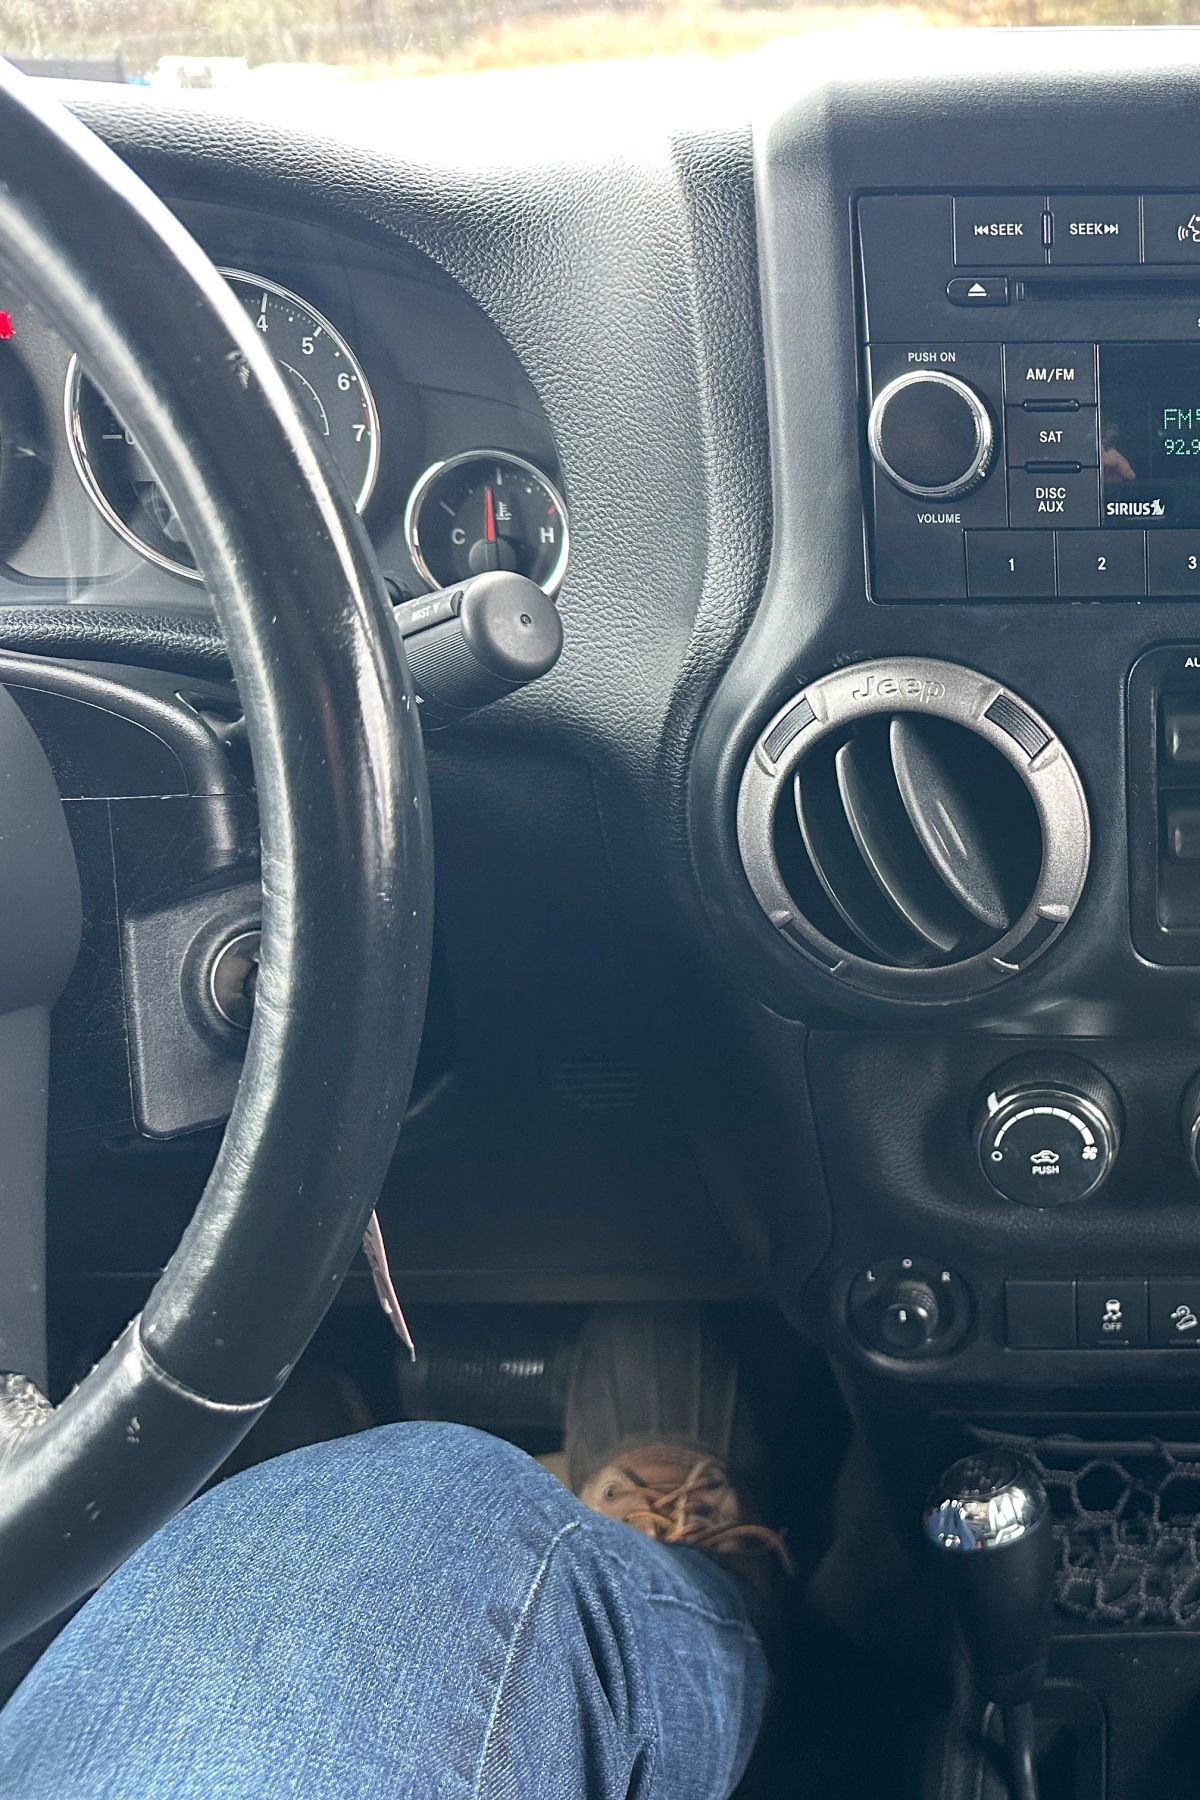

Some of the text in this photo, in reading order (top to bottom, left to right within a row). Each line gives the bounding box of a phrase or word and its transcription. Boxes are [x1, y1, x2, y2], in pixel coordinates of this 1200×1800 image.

[990, 223, 1024, 236] SEEK
[1069, 222, 1103, 236] SEEK
[256, 314, 269, 332] 4
[301, 336, 315, 355] 5
[907, 351, 956, 363] PUSH ON
[337, 372, 351, 391] 6
[1026, 367, 1075, 383] AM/FM
[1163, 408, 1192, 430] FM
[352, 424, 366, 442] 7
[1039, 430, 1064, 443] SAT
[1164, 438, 1200, 456] 92.9
[1035, 487, 1067, 499] DISC
[1037, 500, 1065, 513] AUX
[1106, 502, 1151, 516] SIRIUS
[916, 513, 961, 524] VOLUME
[452, 528, 466, 545] C
[540, 527, 555, 544] H
[1008, 558, 1015, 572] 1
[1097, 556, 1107, 571] 2
[1188, 555, 1198, 570] 3
[411, 605, 432, 622] MIST
[851, 674, 947, 704] Jeep
[1032, 1166, 1060, 1174] PUSH
[866, 1270, 876, 1282] L
[941, 1271, 951, 1282] R
[1102, 1321, 1123, 1331] OFF
